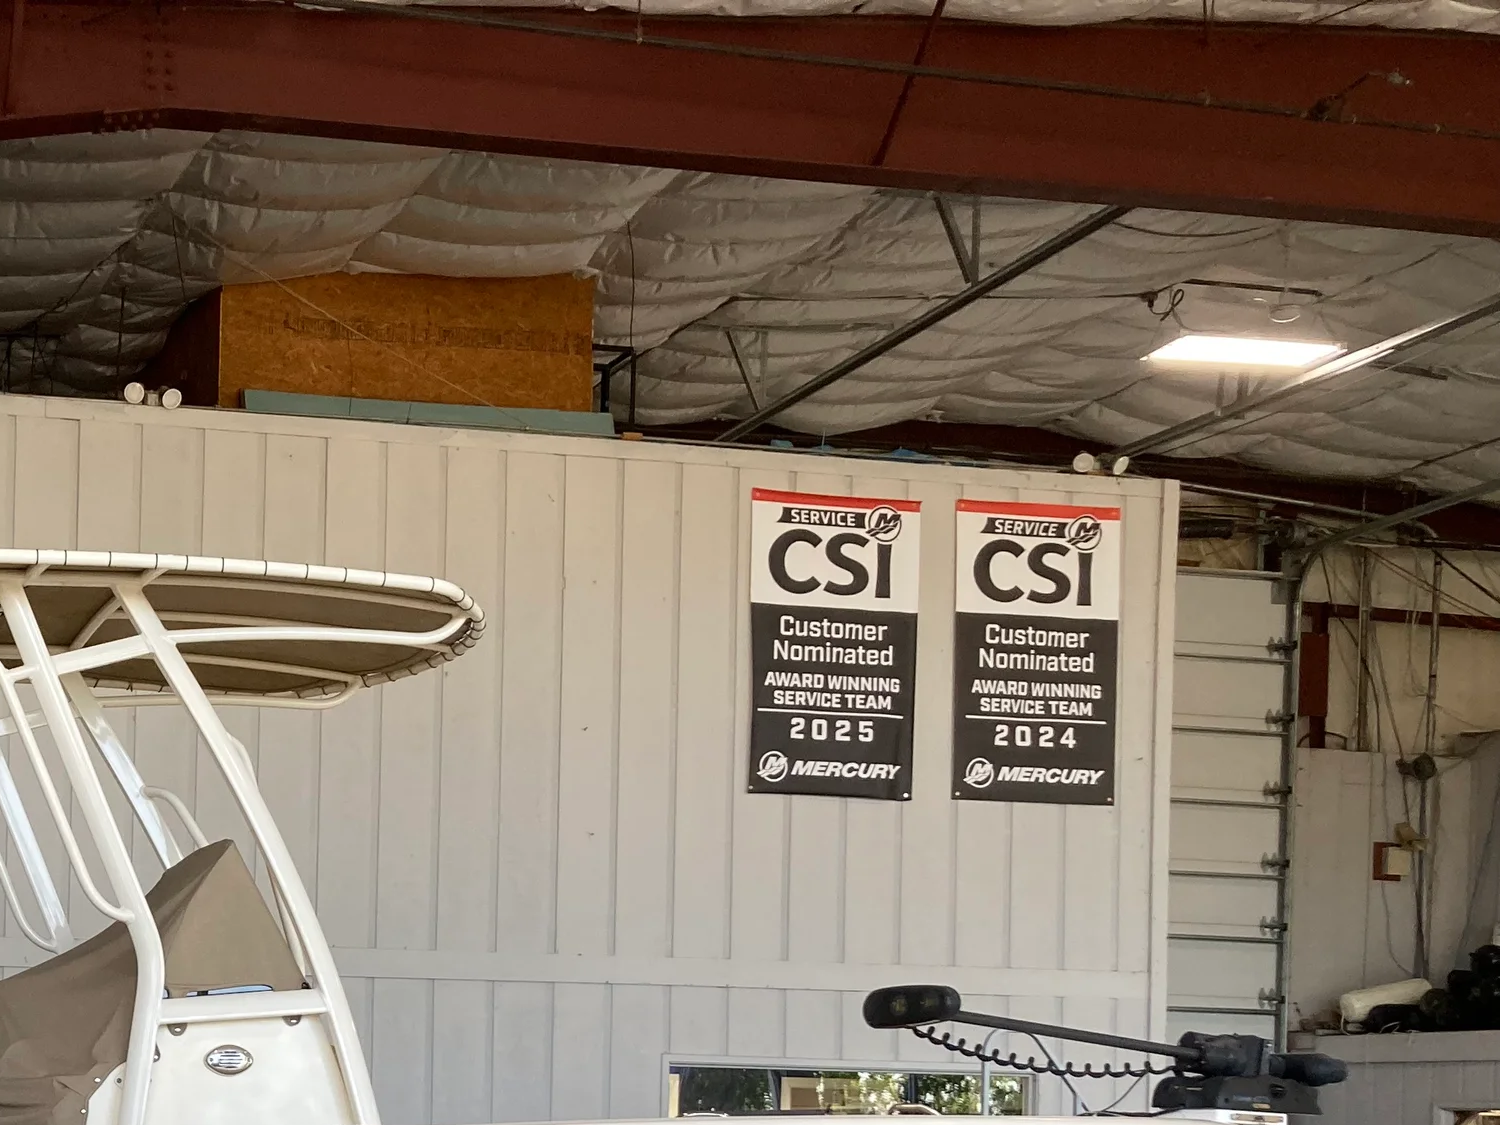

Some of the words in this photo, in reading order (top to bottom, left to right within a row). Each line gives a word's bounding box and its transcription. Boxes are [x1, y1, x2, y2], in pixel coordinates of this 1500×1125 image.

[791, 509, 856, 526] SERVICE
[995, 519, 1058, 537] SERVICE
[780, 615, 888, 641] Customer
[985, 624, 1090, 648] Customer
[773, 640, 894, 666] Nominated
[979, 648, 1094, 673] Nominated
[764, 671, 824, 689] AWARD
[827, 674, 901, 693] WINNING
[971, 679, 1028, 697] AWARD
[1031, 682, 1102, 699] WINNING
[773, 690, 842, 708] SERVICE
[844, 694, 892, 711] TEAM
[980, 697, 1045, 715] SERVICE
[1048, 700, 1093, 717] TEAM
[790, 717, 875, 743] 2025
[994, 724, 1077, 749] 2024
[790, 760, 902, 780] MERCURY
[997, 766, 1105, 786] MERCURY
